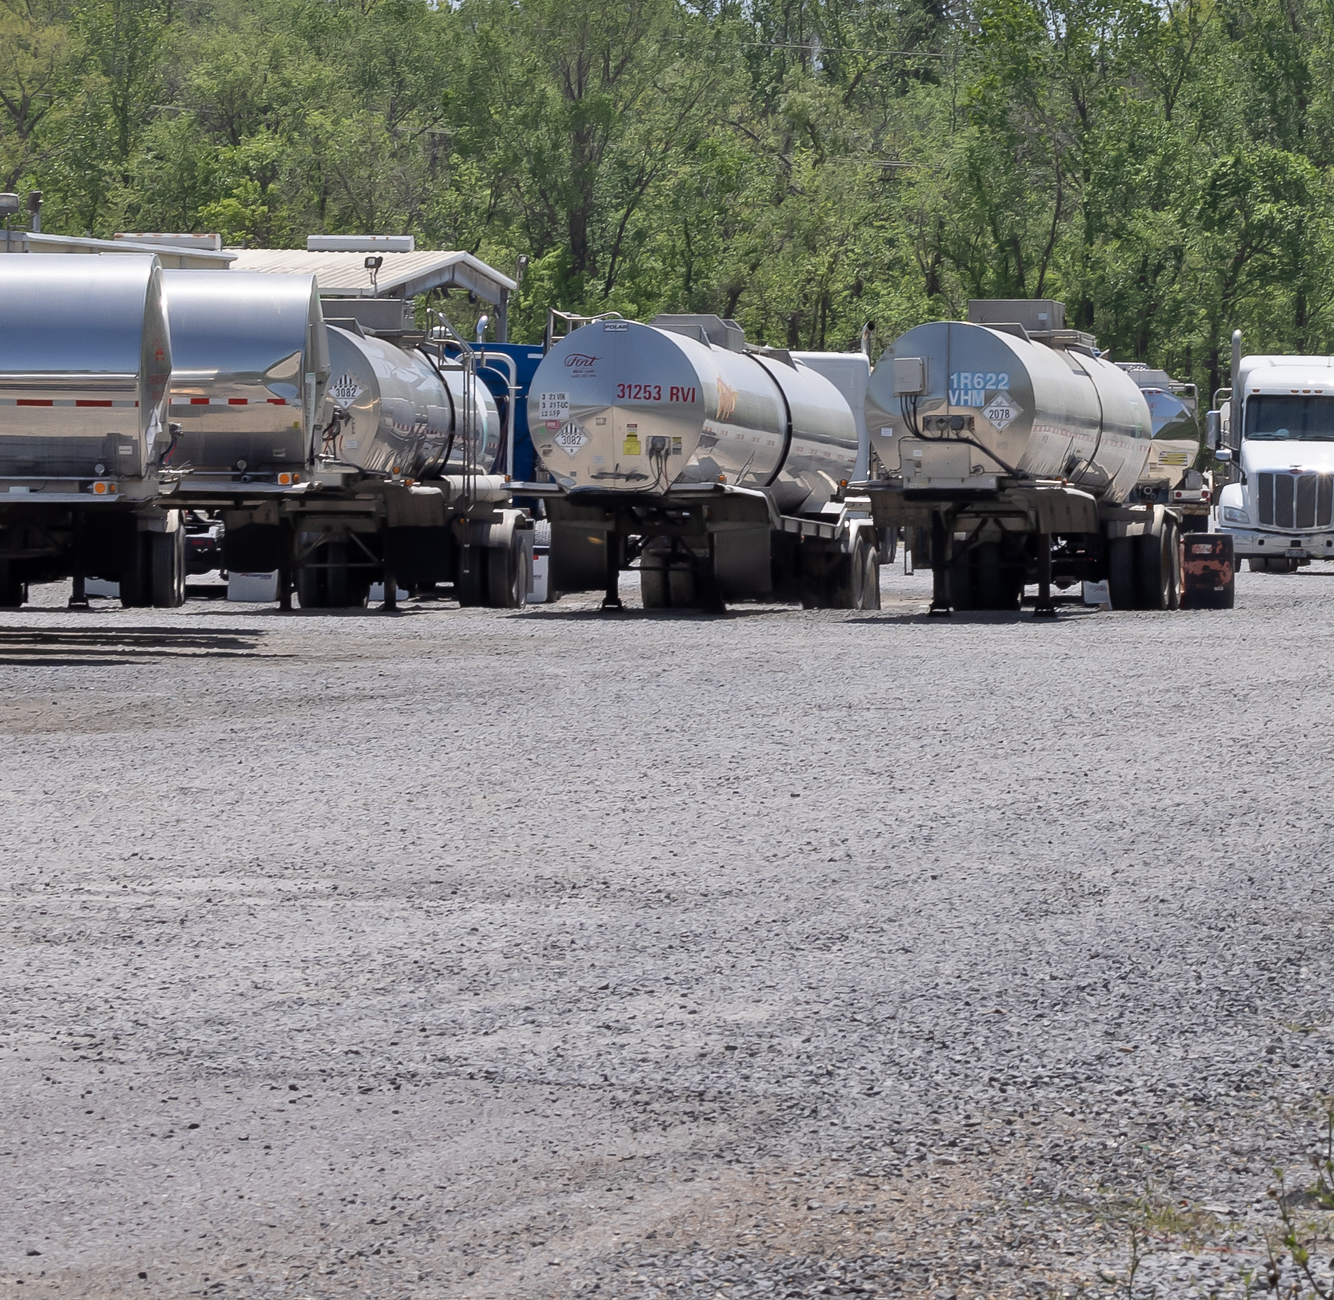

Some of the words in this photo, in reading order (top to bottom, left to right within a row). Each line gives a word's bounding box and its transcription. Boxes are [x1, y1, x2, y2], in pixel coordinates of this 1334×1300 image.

[564, 353, 603, 367] Fort
[950, 372, 1009, 389] 1R622
[335, 387, 357, 397] 3082
[616, 383, 662, 401] 31253
[669, 386, 696, 403] RVI
[948, 390, 985, 406] VHM
[988, 409, 1010, 419] 2078
[561, 435, 582, 445] 3082
